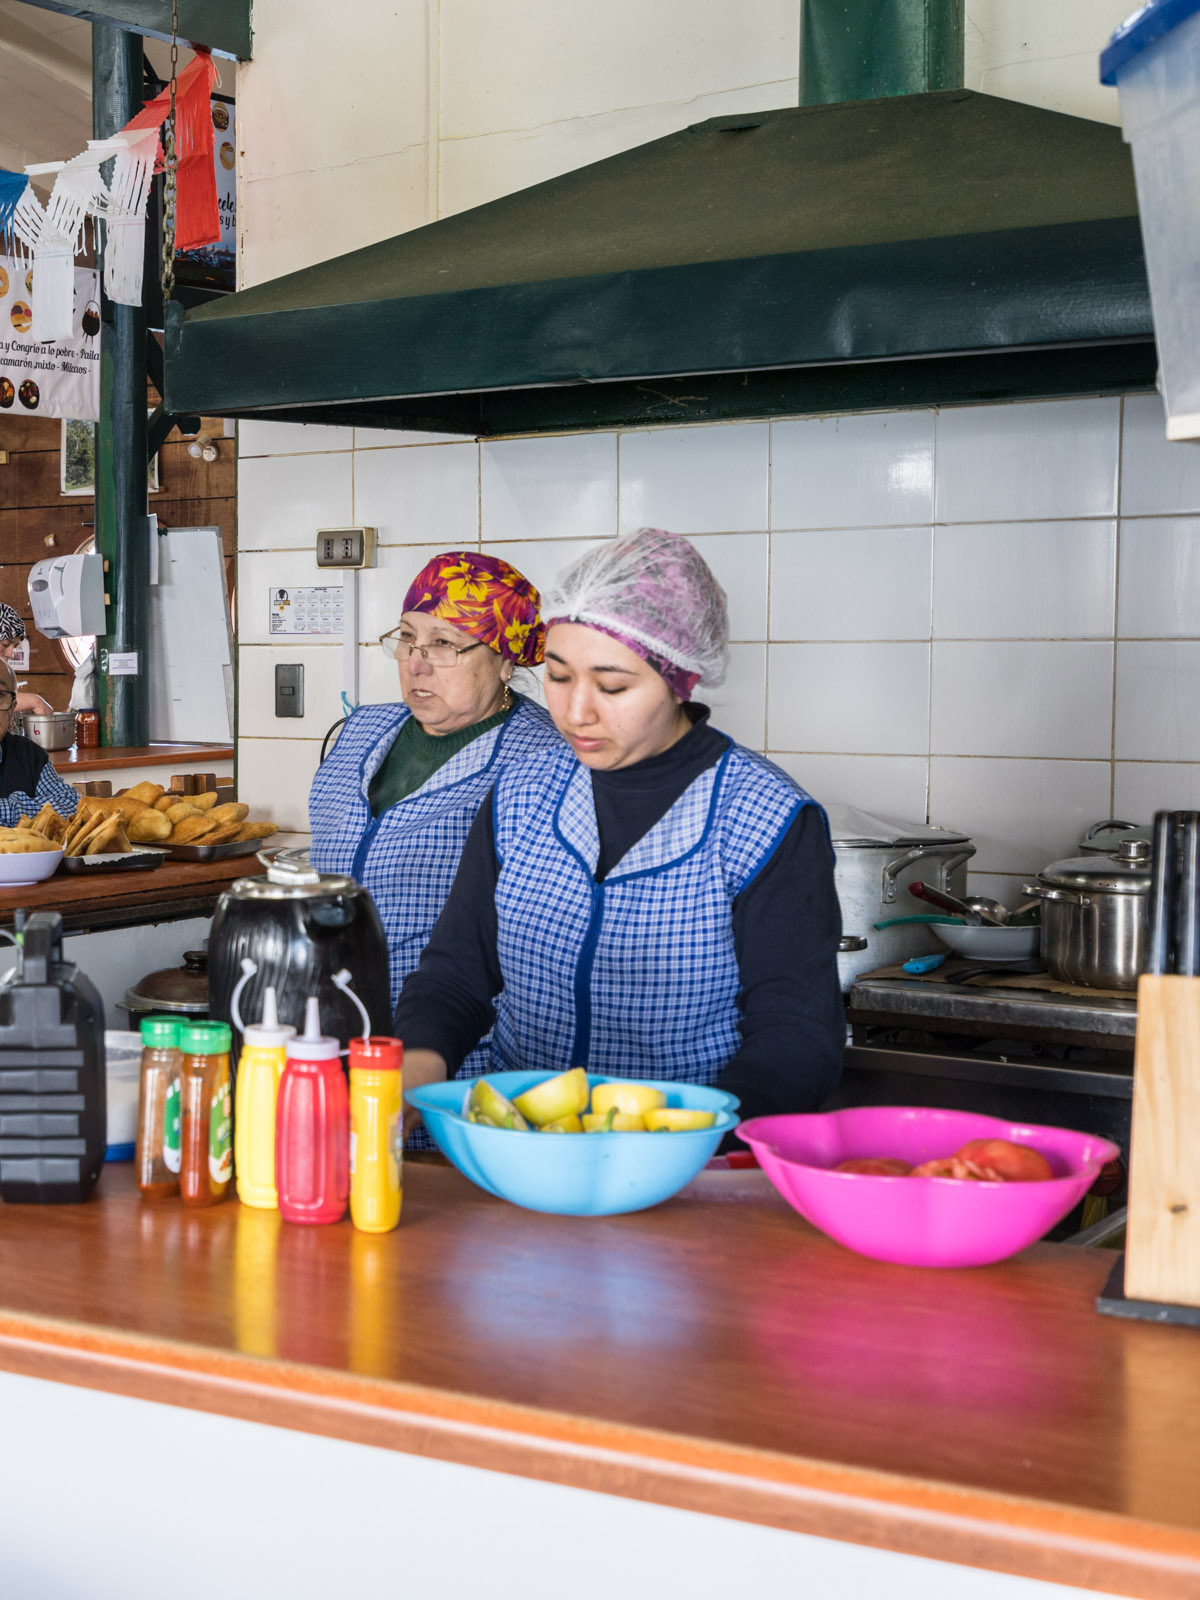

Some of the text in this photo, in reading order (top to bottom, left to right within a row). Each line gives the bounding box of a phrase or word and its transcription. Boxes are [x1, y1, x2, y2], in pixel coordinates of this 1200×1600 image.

[5, 342, 10, 353] y
[11, 340, 41, 355] Congrio
[55, 346, 76, 359] pobre
[80, 350, 100, 361] Paila
[0, 357, 33, 369] camarón
